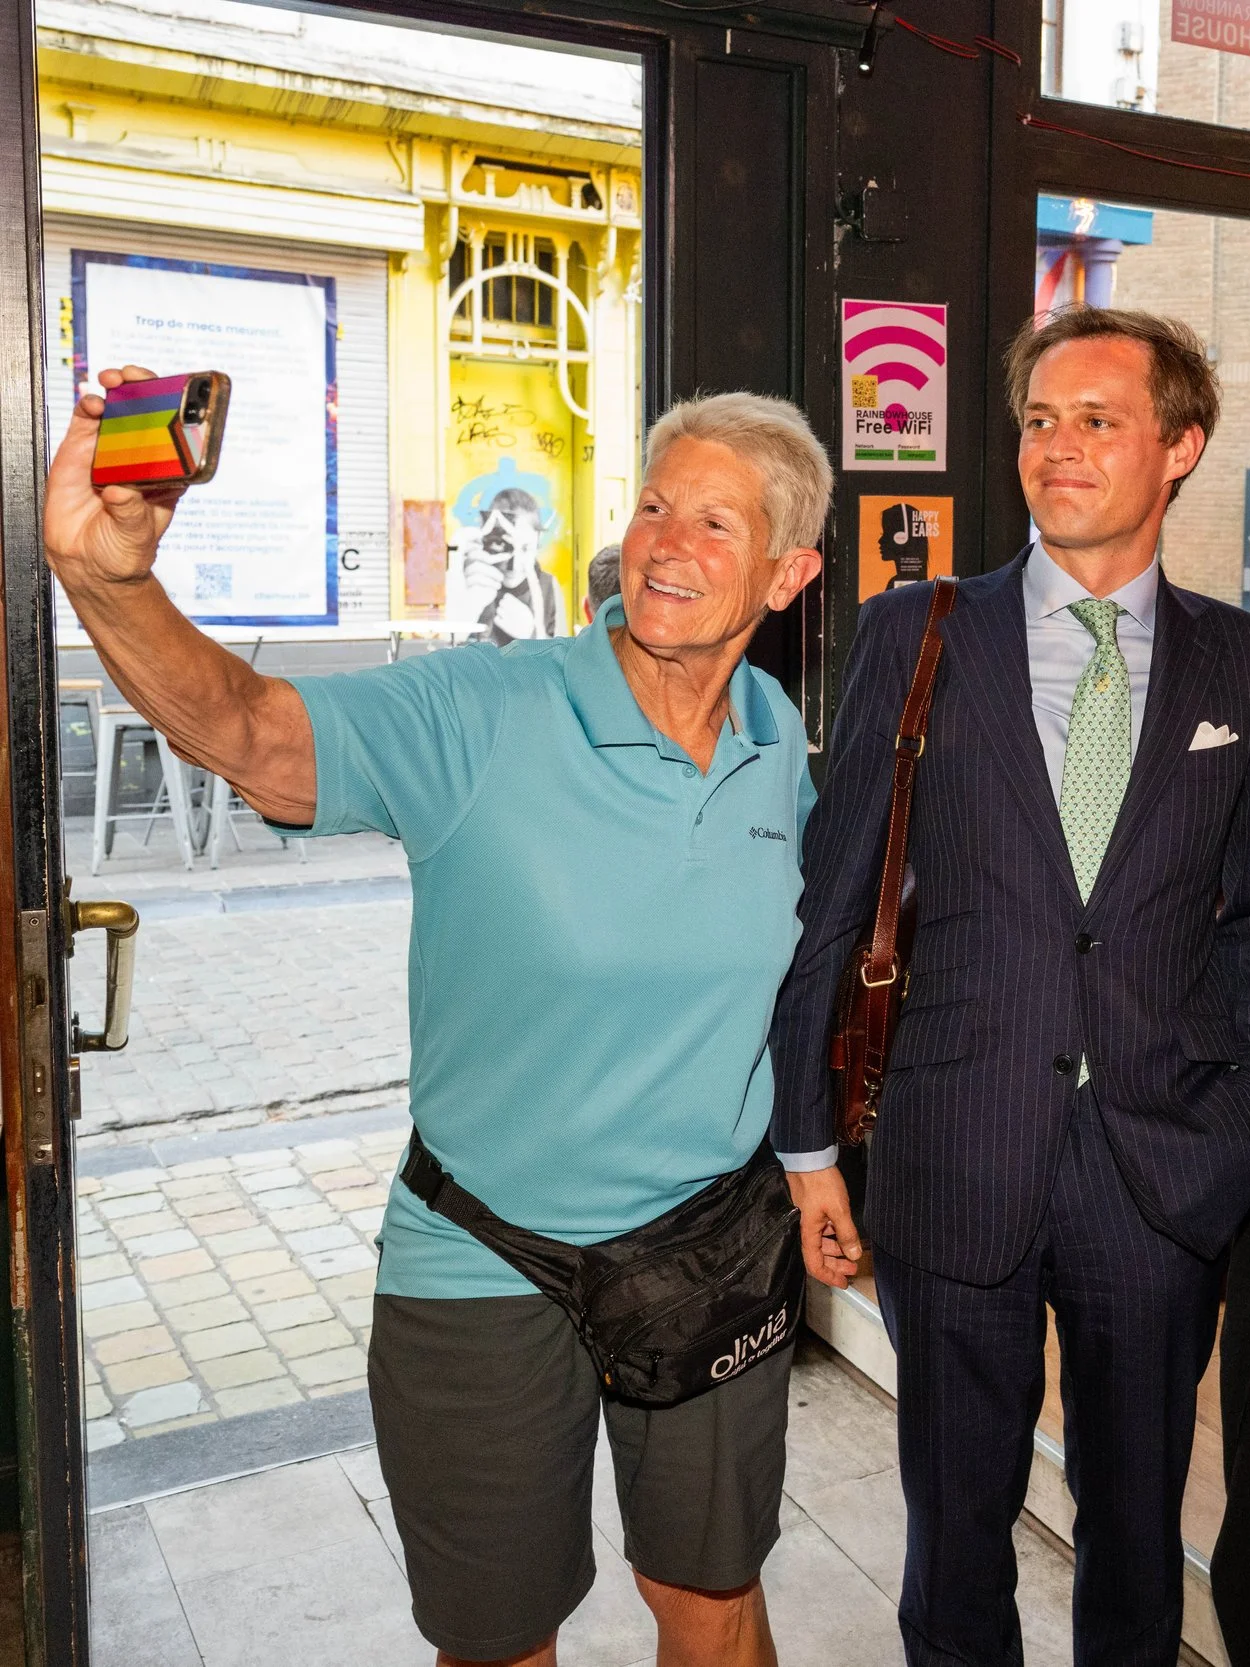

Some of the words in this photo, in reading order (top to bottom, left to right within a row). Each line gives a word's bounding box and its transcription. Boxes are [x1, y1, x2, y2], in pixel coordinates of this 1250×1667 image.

[135, 315, 164, 329] Trop
[167, 318, 183, 329] de
[187, 322, 222, 333] mecs
[856, 409, 933, 421] RAINBOWHOUSE
[856, 419, 893, 434] Free
[897, 420, 931, 435] WiFi
[912, 510, 940, 522] HAPPY
[912, 522, 940, 538] EARS
[341, 548, 360, 571] C
[757, 827, 787, 842] Columbia
